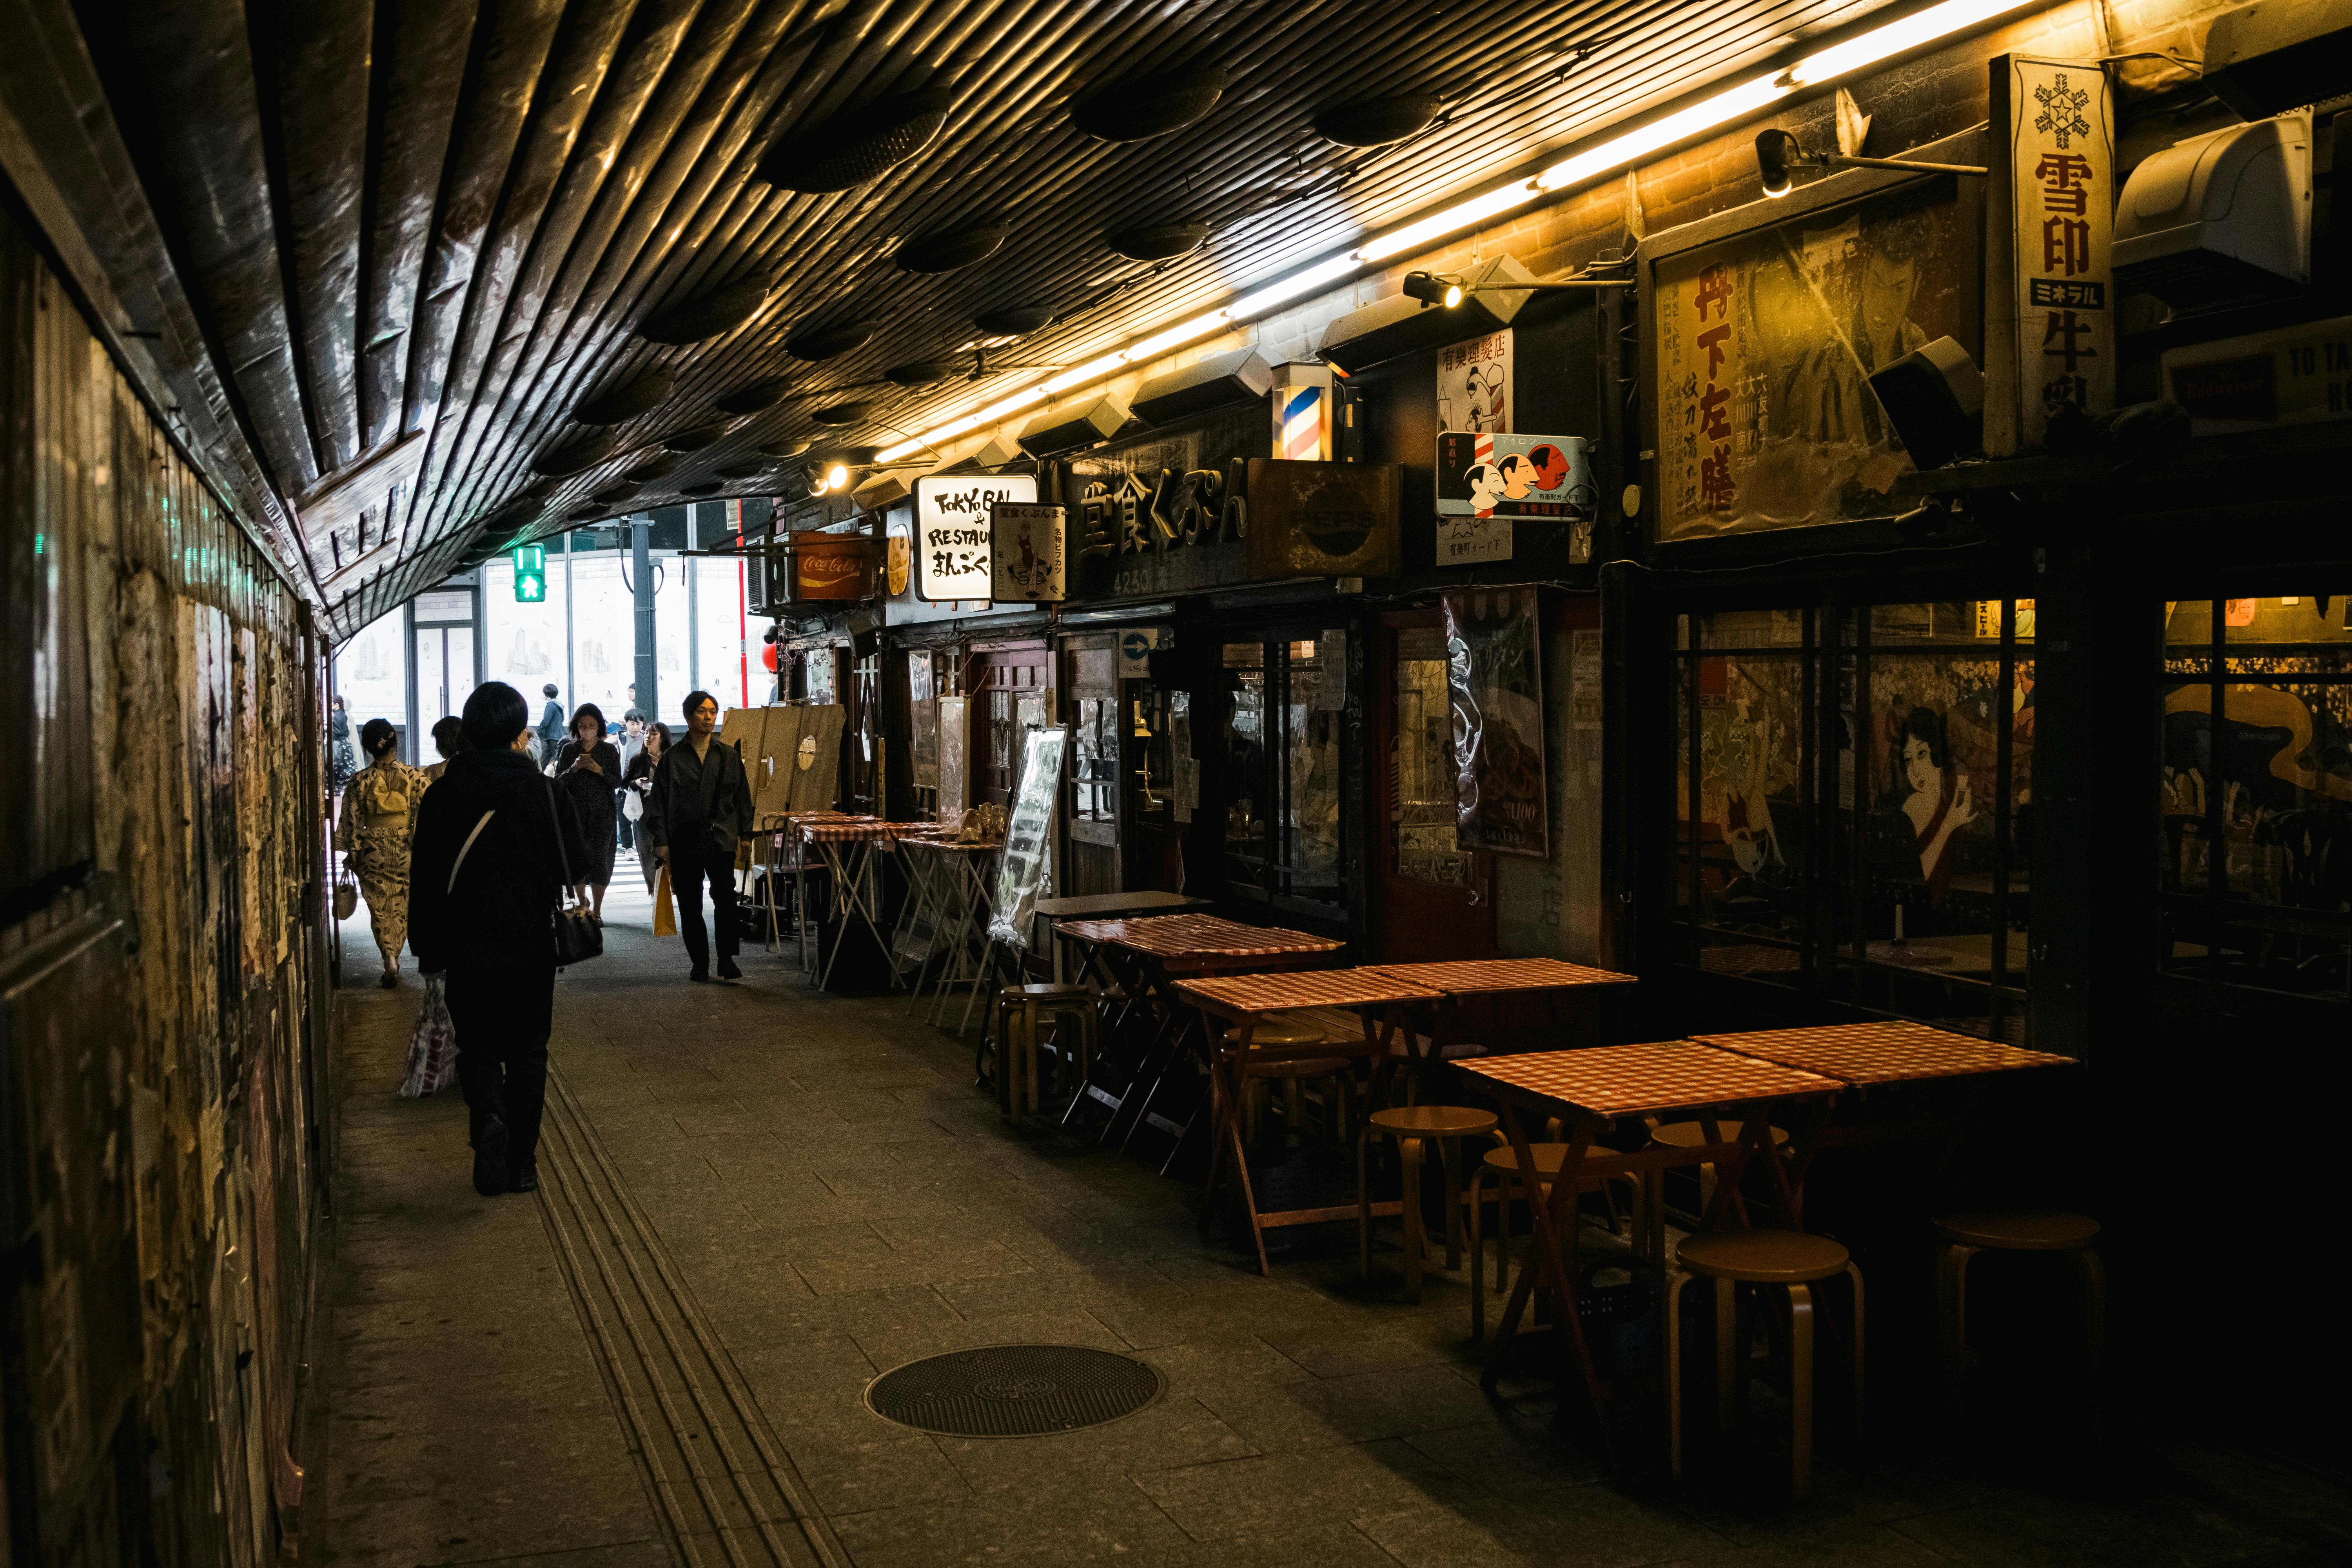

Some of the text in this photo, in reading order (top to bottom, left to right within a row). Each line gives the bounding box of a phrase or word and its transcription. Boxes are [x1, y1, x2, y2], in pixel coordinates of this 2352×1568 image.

[2034, 153, 2092, 277] 雪印
[2036, 283, 2099, 306] ミネラル
[2185, 378, 2265, 401] Budweiser
[1501, 437, 1537, 445] アイロン
[974, 512, 985, 525] &
[928, 529, 991, 547] RESTAU
[803, 555, 855, 572] Coca-Cola
